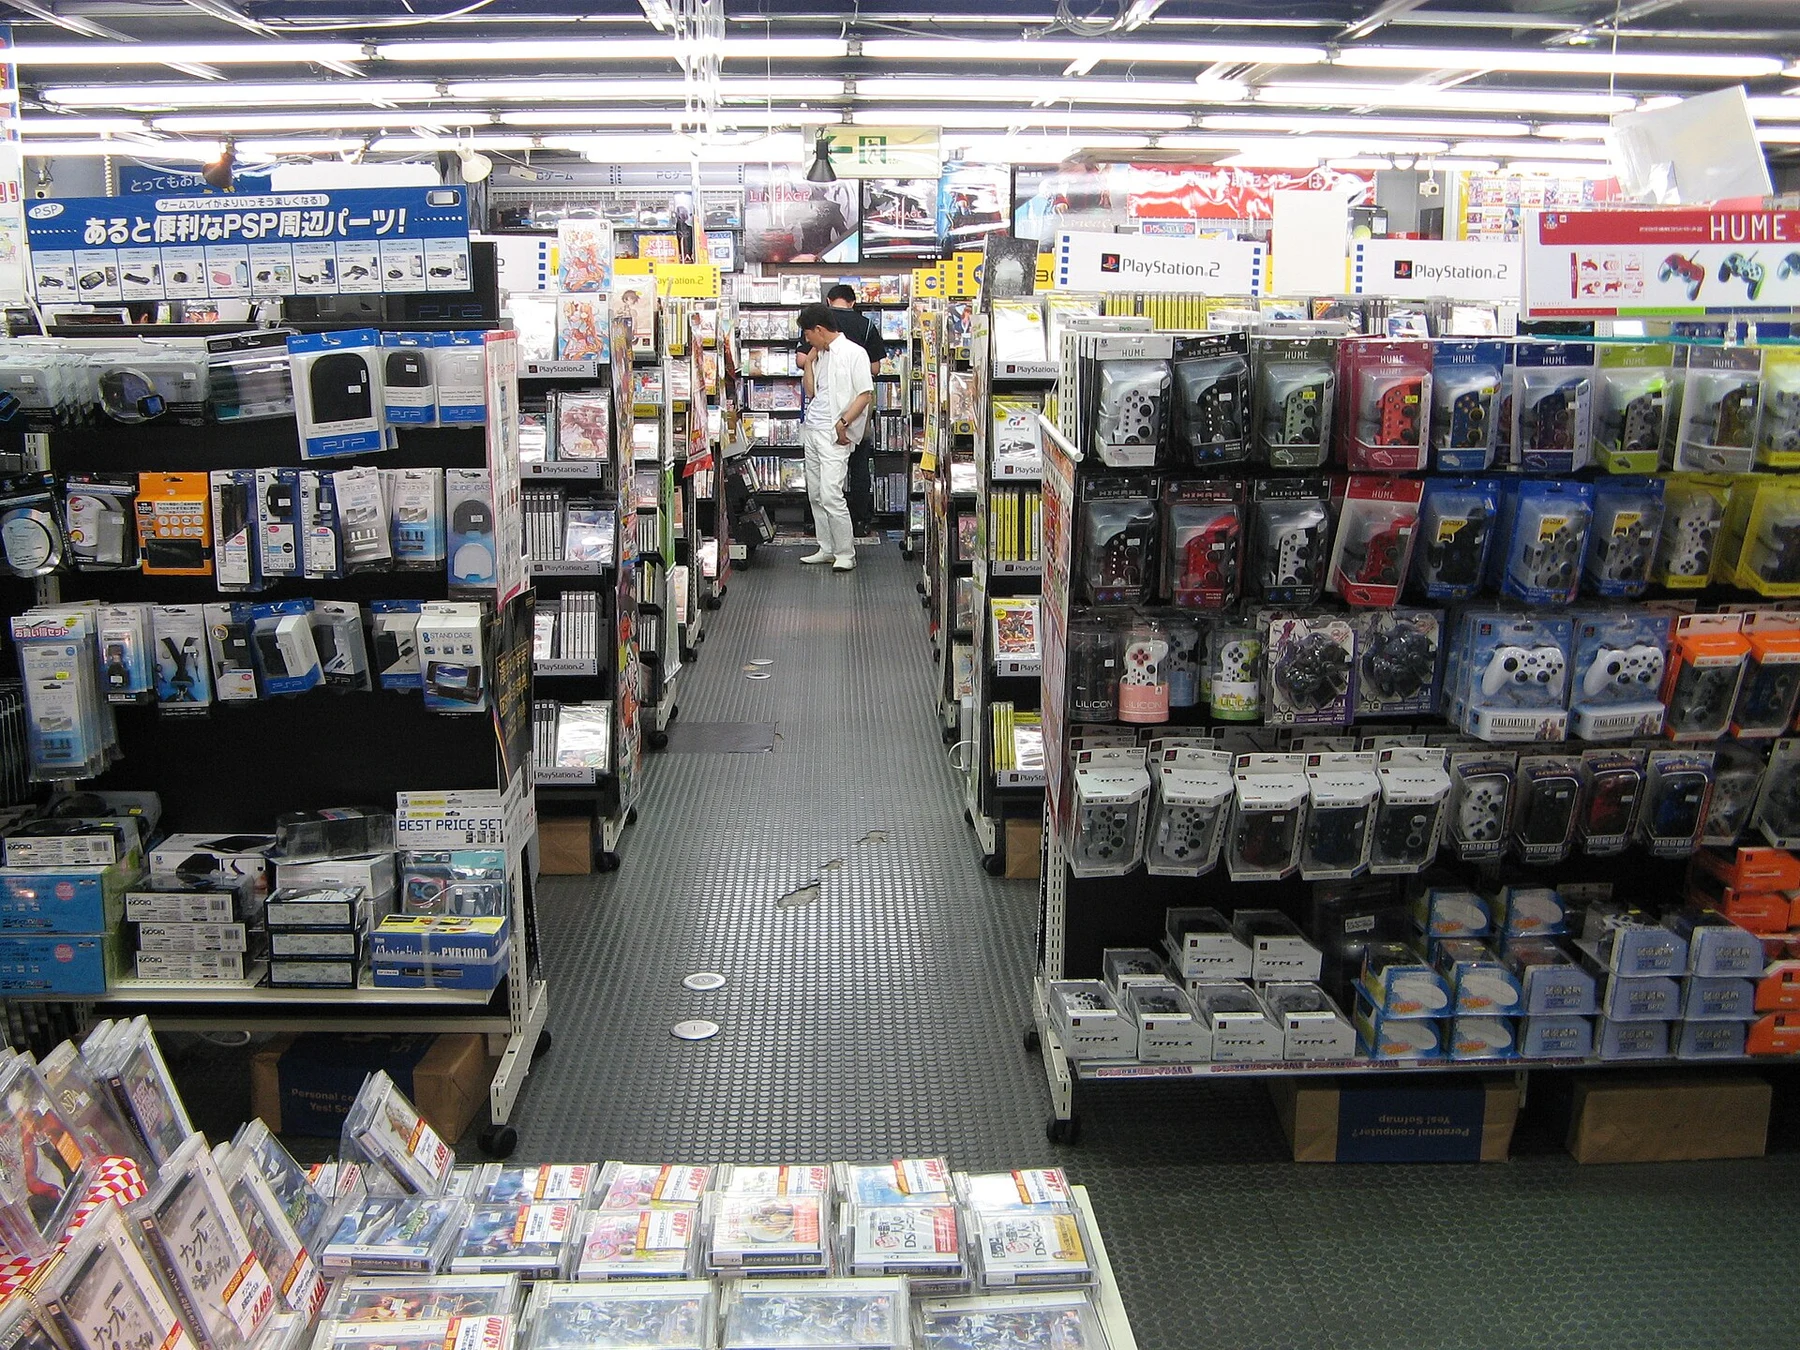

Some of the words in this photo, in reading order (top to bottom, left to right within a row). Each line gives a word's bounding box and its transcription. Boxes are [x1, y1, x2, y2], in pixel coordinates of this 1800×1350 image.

[656, 170, 703, 180] PCゲー
[34, 204, 58, 217] PSP
[84, 207, 407, 246] あると便利なPSP周辺パーツ!
[1709, 214, 1787, 242] HUME
[1121, 349, 1146, 357] HUME
[1284, 351, 1309, 360] HUME
[1380, 355, 1404, 364] HUME
[1452, 354, 1477, 364] HUME
[1542, 356, 1567, 365] HUME
[1713, 359, 1735, 368] HUME
[390, 410, 421, 418] PSP
[450, 408, 477, 416] PSP
[323, 437, 366, 450] PSP
[450, 484, 472, 492] SLIDE
[1371, 490, 1395, 500] HUME
[259, 486, 267, 522] COVER
[14, 627, 69, 638] お買い得セット
[430, 632, 453, 640] STAND
[272, 680, 301, 690] PSP
[399, 819, 431, 831] BEST
[435, 819, 476, 831] PRICE
[441, 947, 488, 960] PVR1000
[291, 1088, 339, 1101] Personal
[310, 1102, 332, 1113] Yes!
[1378, 1114, 1424, 1125] Sofmap
[1426, 1115, 1450, 1124] Yes!
[1352, 1126, 1416, 1138] computer?
[1418, 1127, 1470, 1138] Personal
[483, 1317, 502, 1348] ¥3,800
